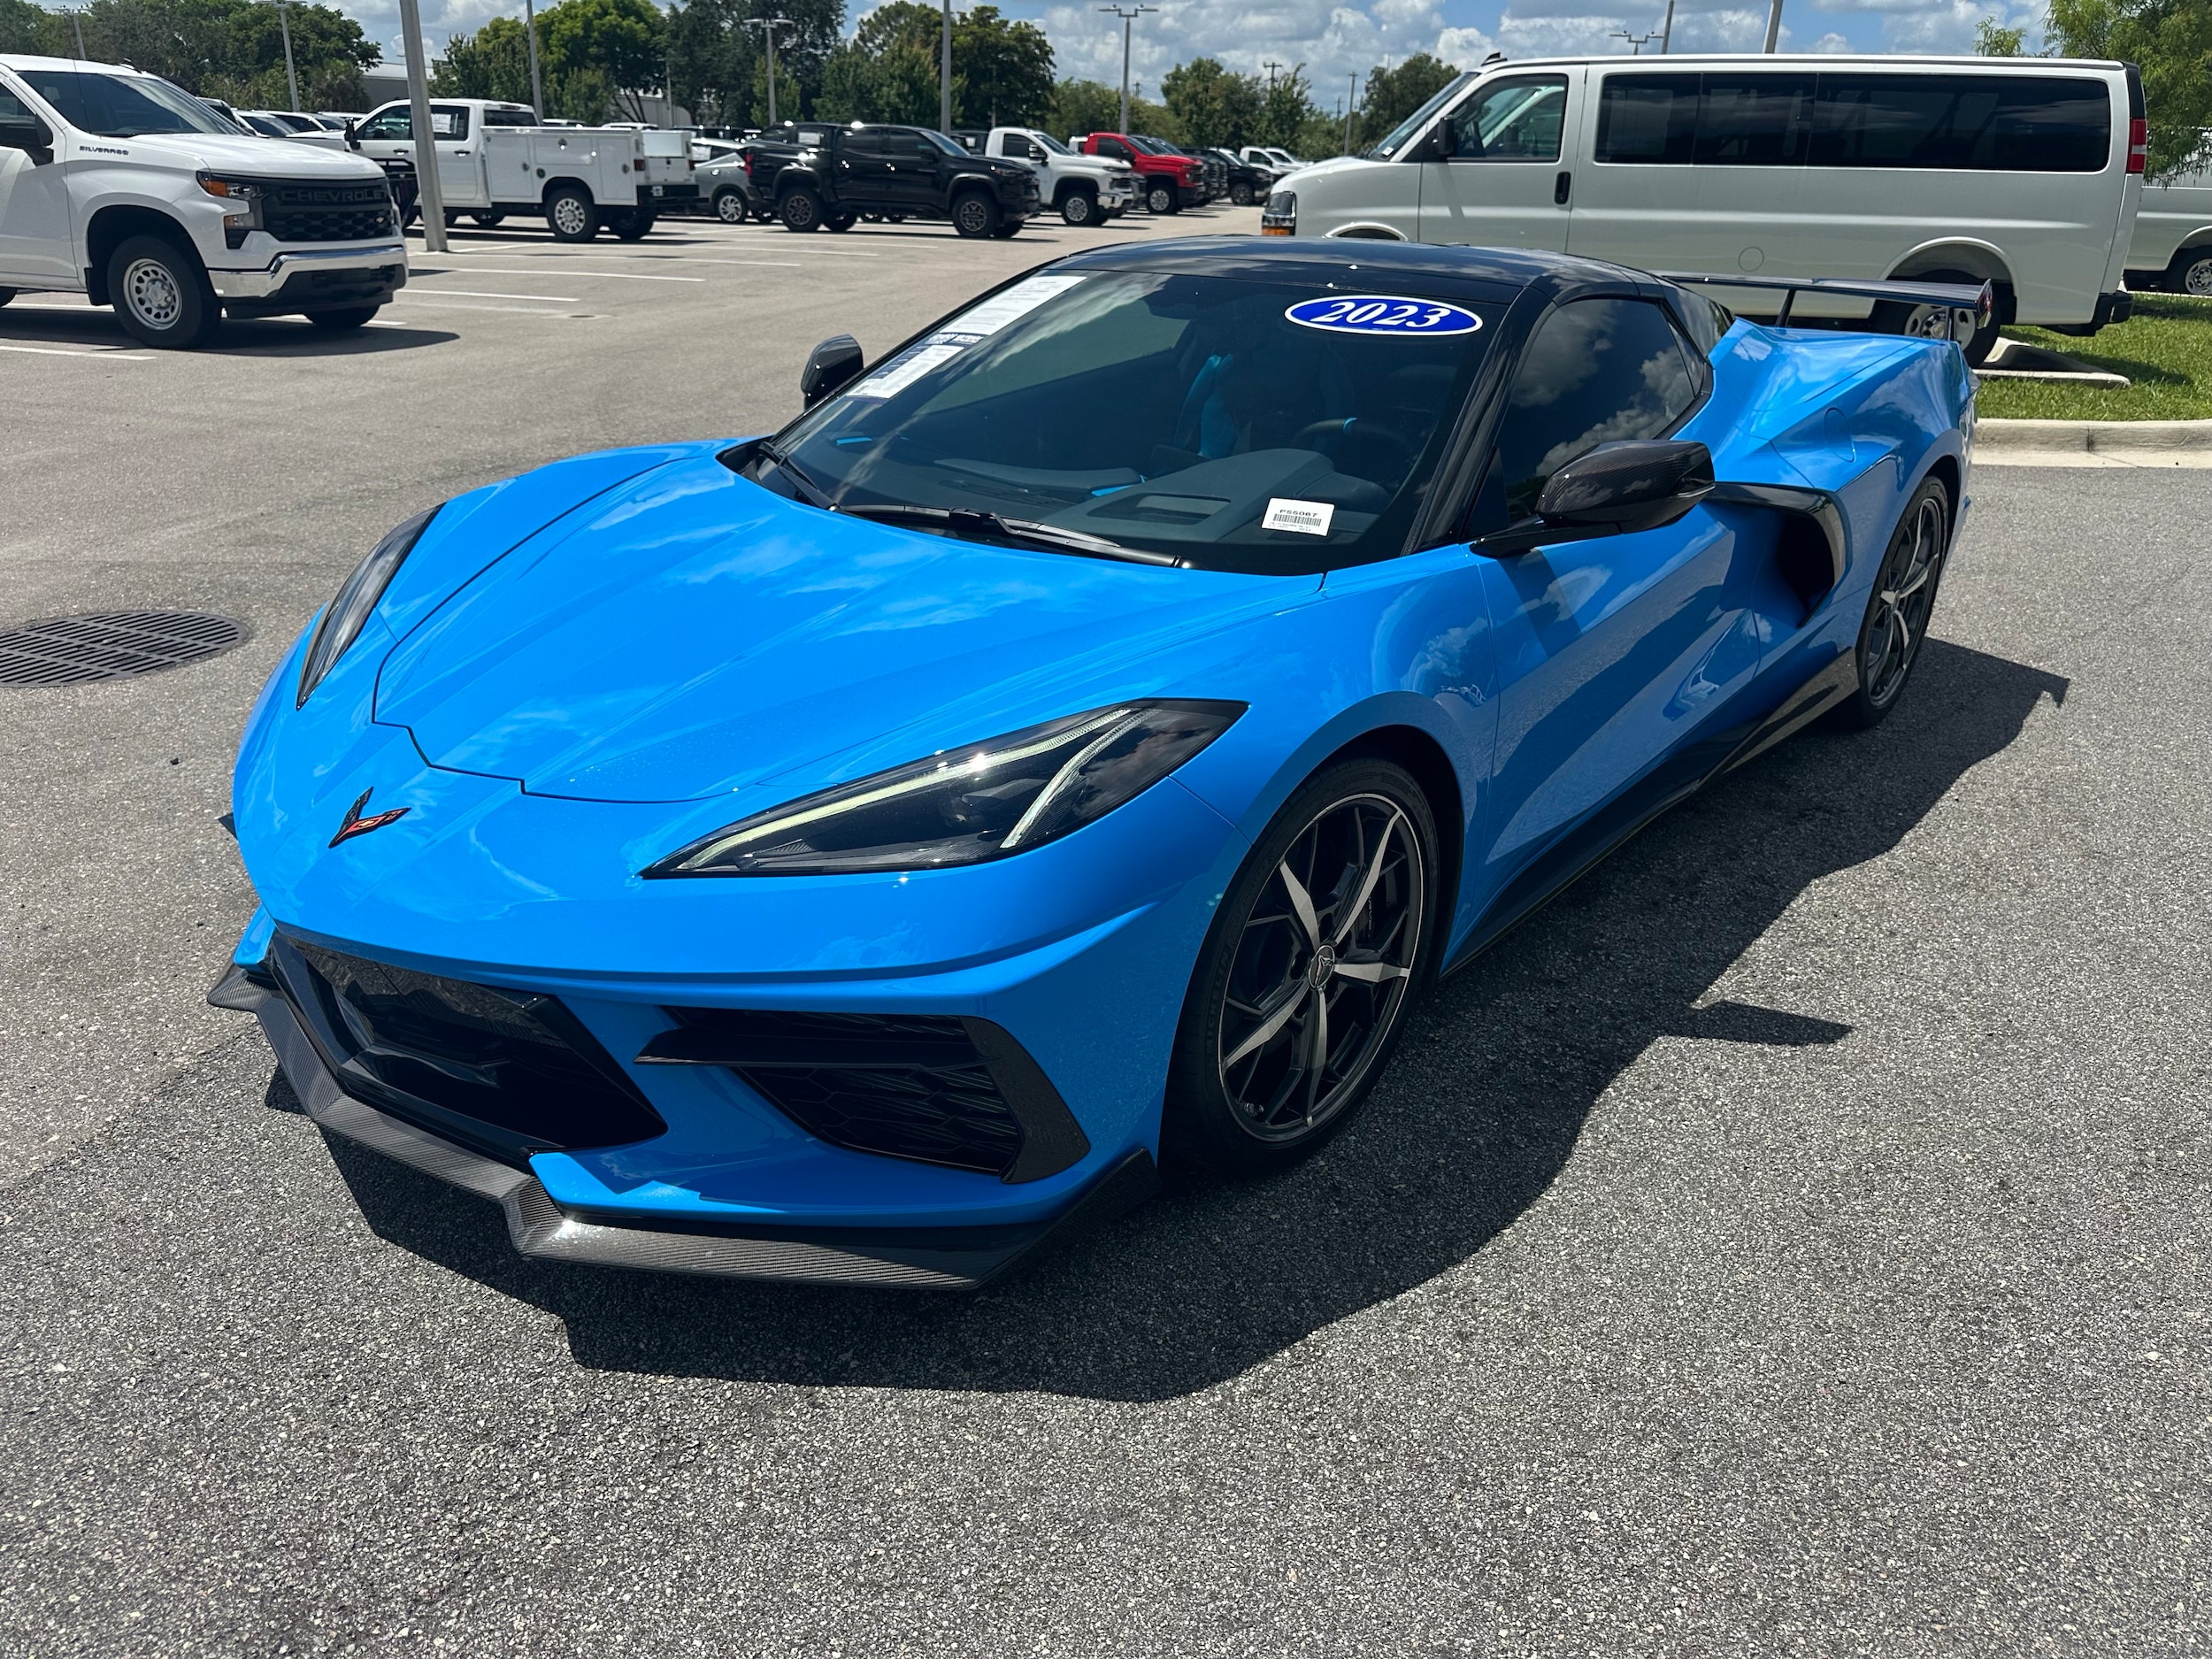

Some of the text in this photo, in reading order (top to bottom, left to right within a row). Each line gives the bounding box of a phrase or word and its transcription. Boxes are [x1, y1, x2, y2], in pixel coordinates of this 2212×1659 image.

[80, 145, 129, 156] SILVERADO
[280, 188, 388, 202] CHEVROLET
[1310, 301, 1452, 328] 2023
